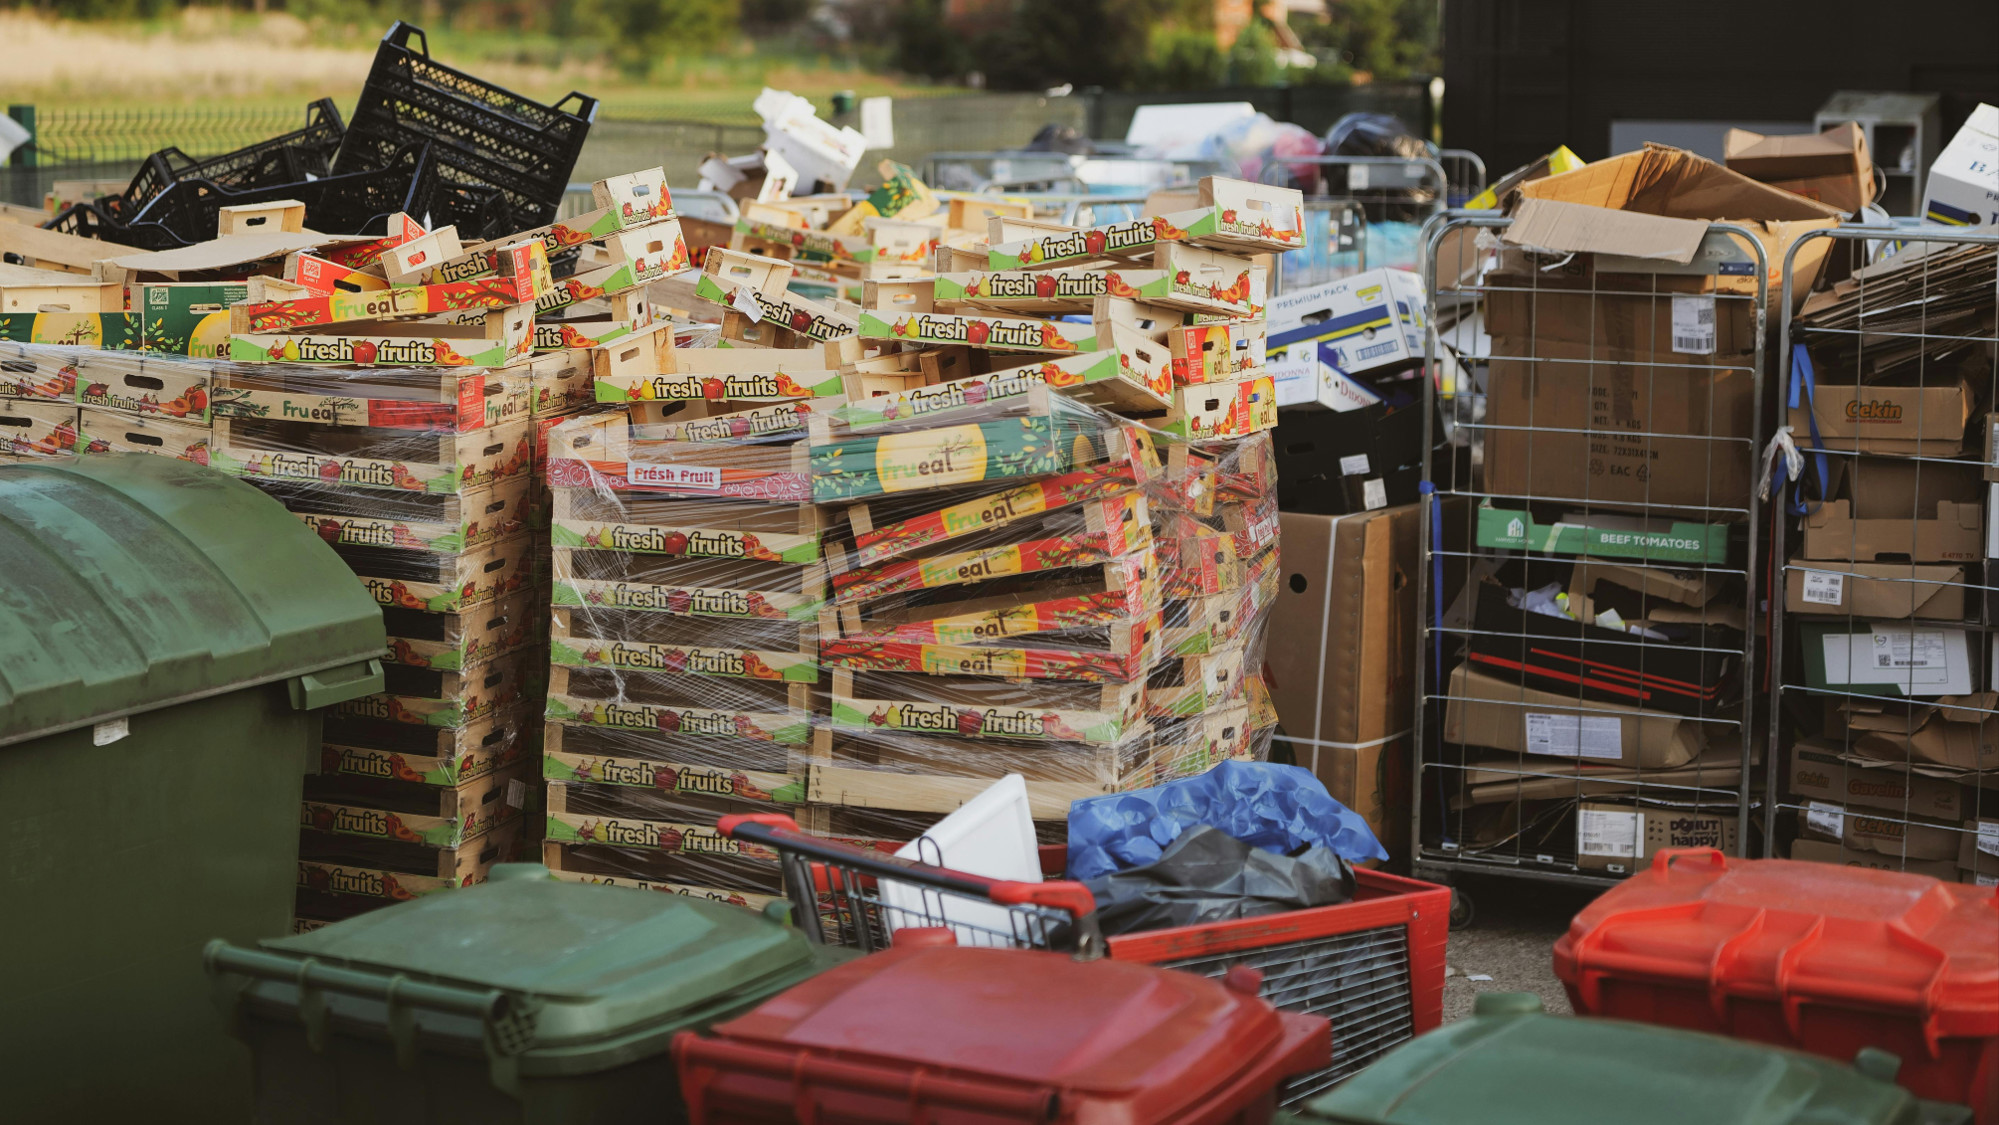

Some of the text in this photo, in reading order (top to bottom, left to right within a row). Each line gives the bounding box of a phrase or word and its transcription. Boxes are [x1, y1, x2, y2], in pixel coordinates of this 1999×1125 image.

[1041, 221, 1157, 260] fresh fruits
[1220, 219, 1260, 237] fresh fruits
[441, 251, 492, 283] fresh
[989, 272, 1108, 297] fresh fruits
[1277, 284, 1350, 310] PREMIUM PACK
[335, 291, 399, 319] Frueat
[918, 311, 1042, 348] fresh fruits
[298, 338, 436, 363] fresh fruits
[82, 391, 139, 411] fresh fruits
[653, 375, 778, 400] fresh fruits
[910, 367, 1046, 414] fresh fruits
[685, 409, 801, 442] fresh fruits
[272, 454, 394, 486] fresh fruits
[882, 450, 954, 480] Frueat
[946, 496, 1016, 532] Frueat
[340, 519, 394, 546] fruits
[612, 524, 745, 557] fresh fruits
[1600, 532, 1700, 550] BEEF TOMATOES
[923, 554, 992, 584] Frueat
[615, 585, 749, 614] fresh fruits
[938, 616, 1008, 645] Frueat
[612, 644, 745, 675] fresh fruits
[605, 705, 738, 736] fresh fruits
[900, 704, 1044, 735] fresh fruits
[340, 752, 392, 777] fruits
[602, 759, 734, 794] fresh fruits
[336, 807, 389, 835] fruits
[605, 821, 740, 855] fresh fruits
[330, 868, 384, 896] fruits
